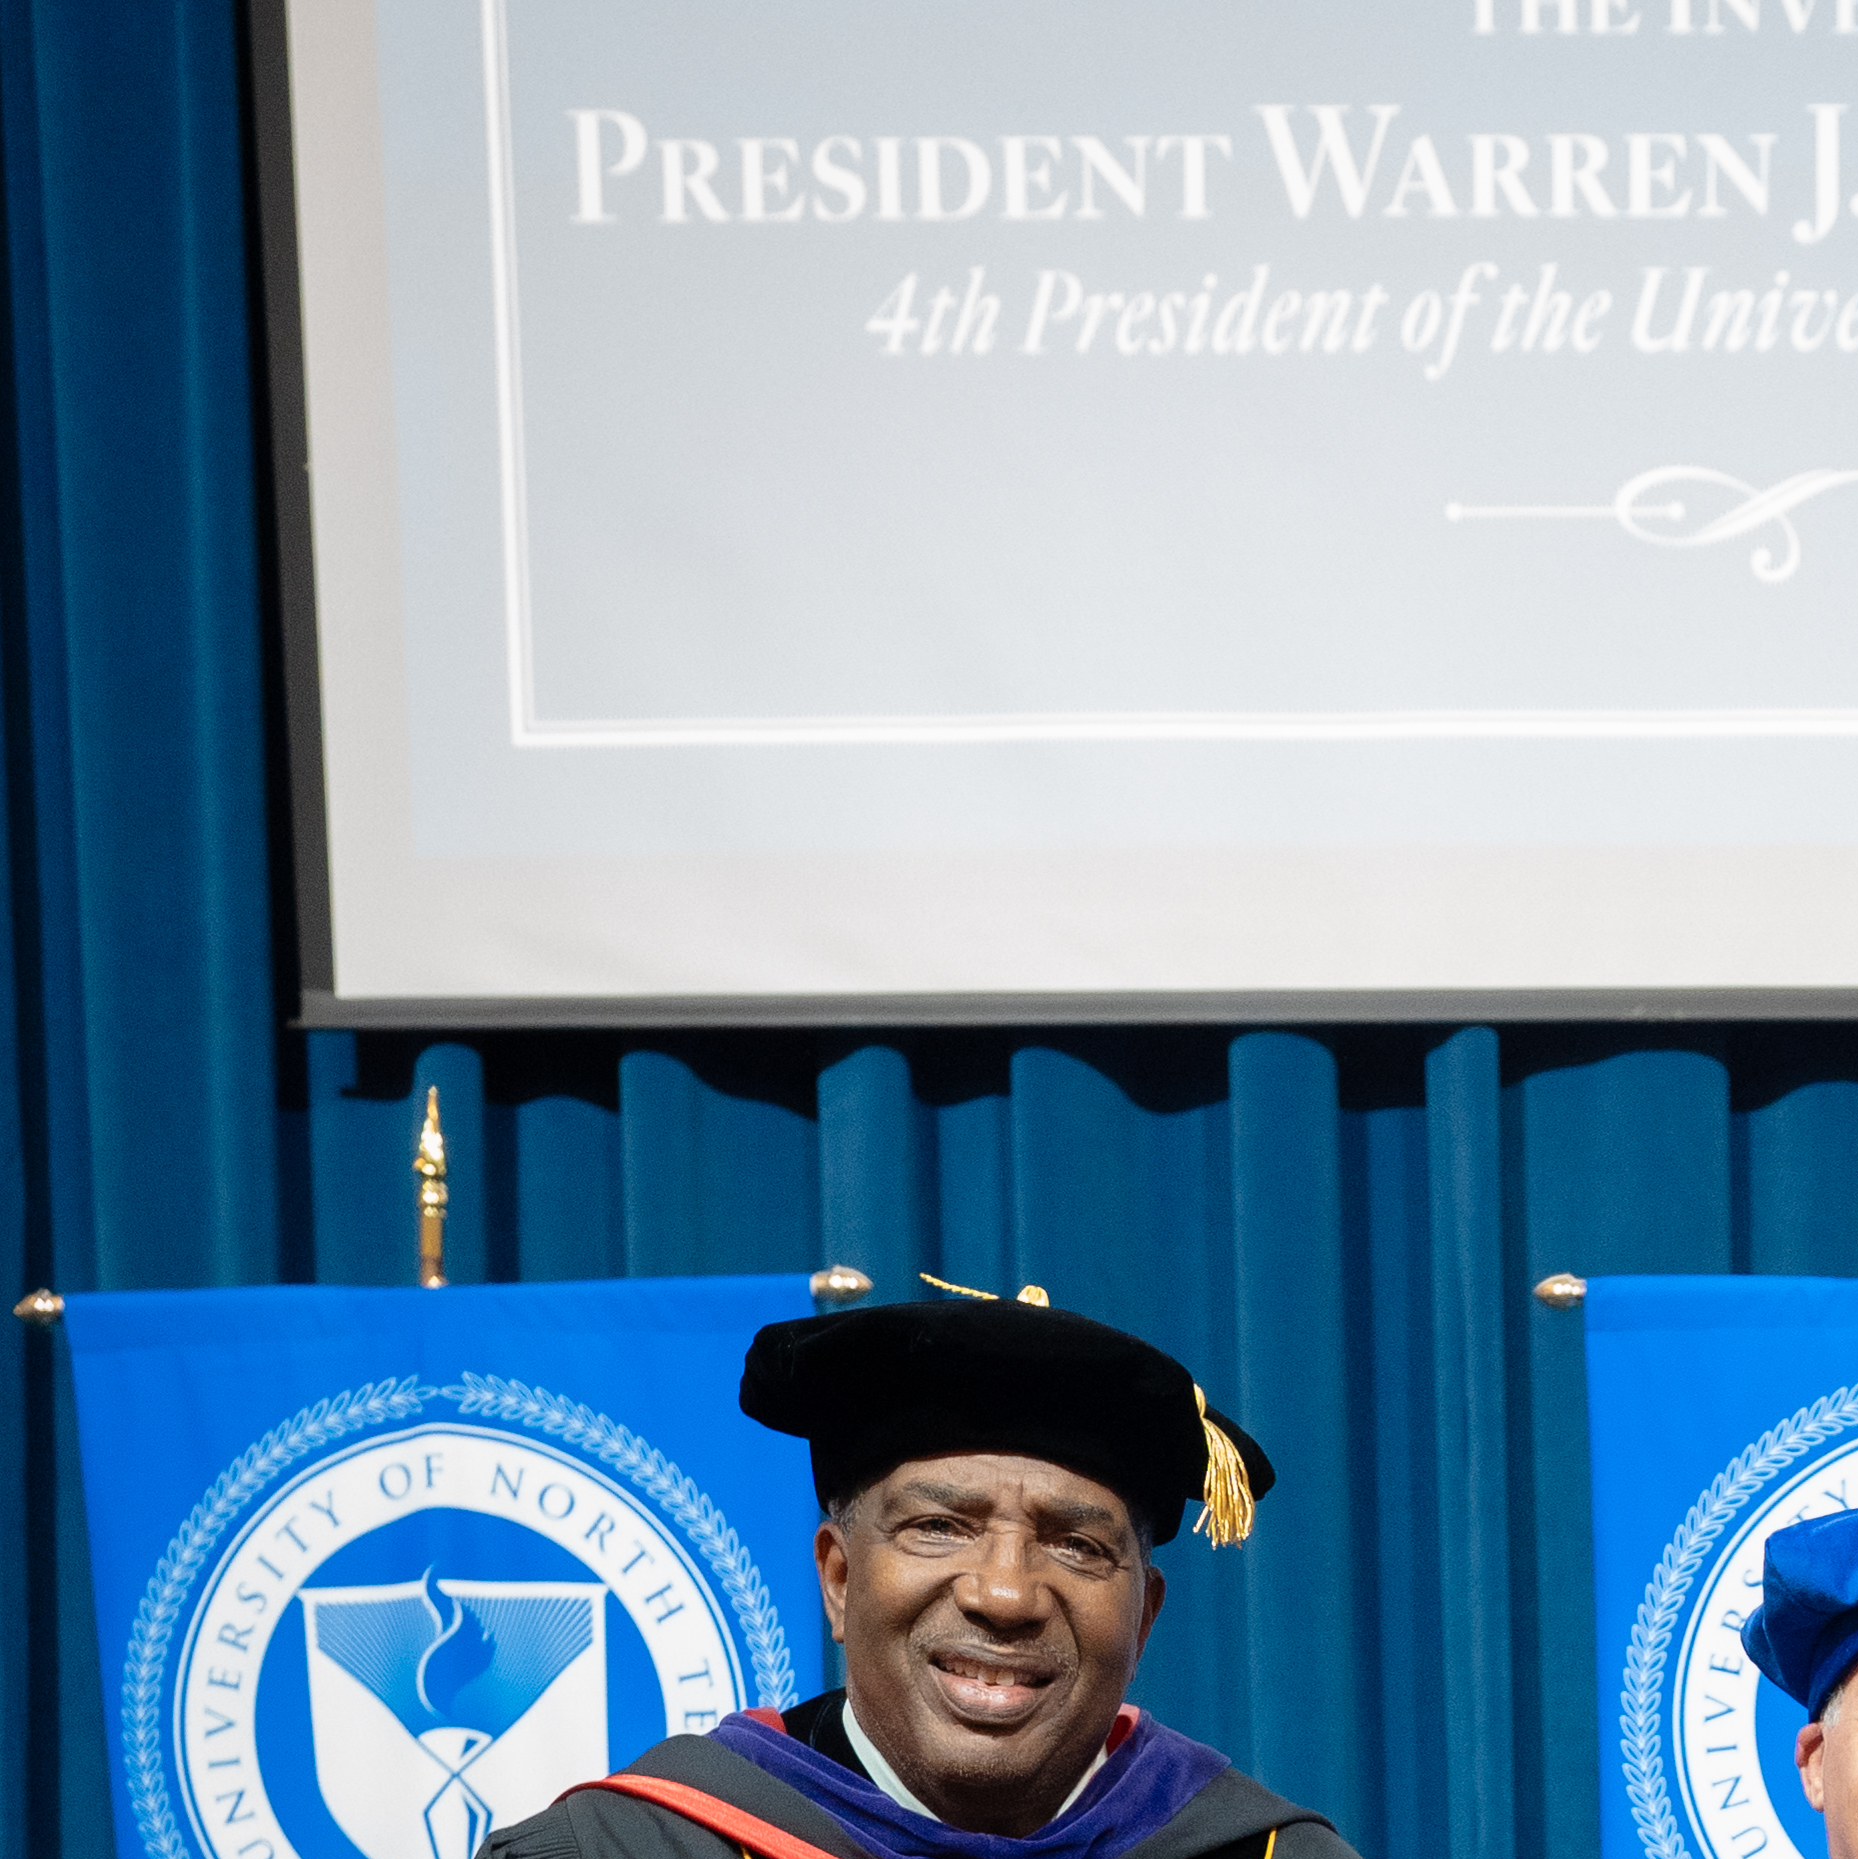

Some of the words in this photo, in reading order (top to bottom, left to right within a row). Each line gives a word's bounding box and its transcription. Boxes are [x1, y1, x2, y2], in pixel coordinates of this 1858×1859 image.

[864, 265, 1001, 357] 4th
[1019, 262, 1391, 357] President
[1400, 261, 1500, 383] of
[1489, 261, 1614, 355] the
[378, 1452, 444, 1500] OF
[490, 1462, 685, 1625] NORTH
